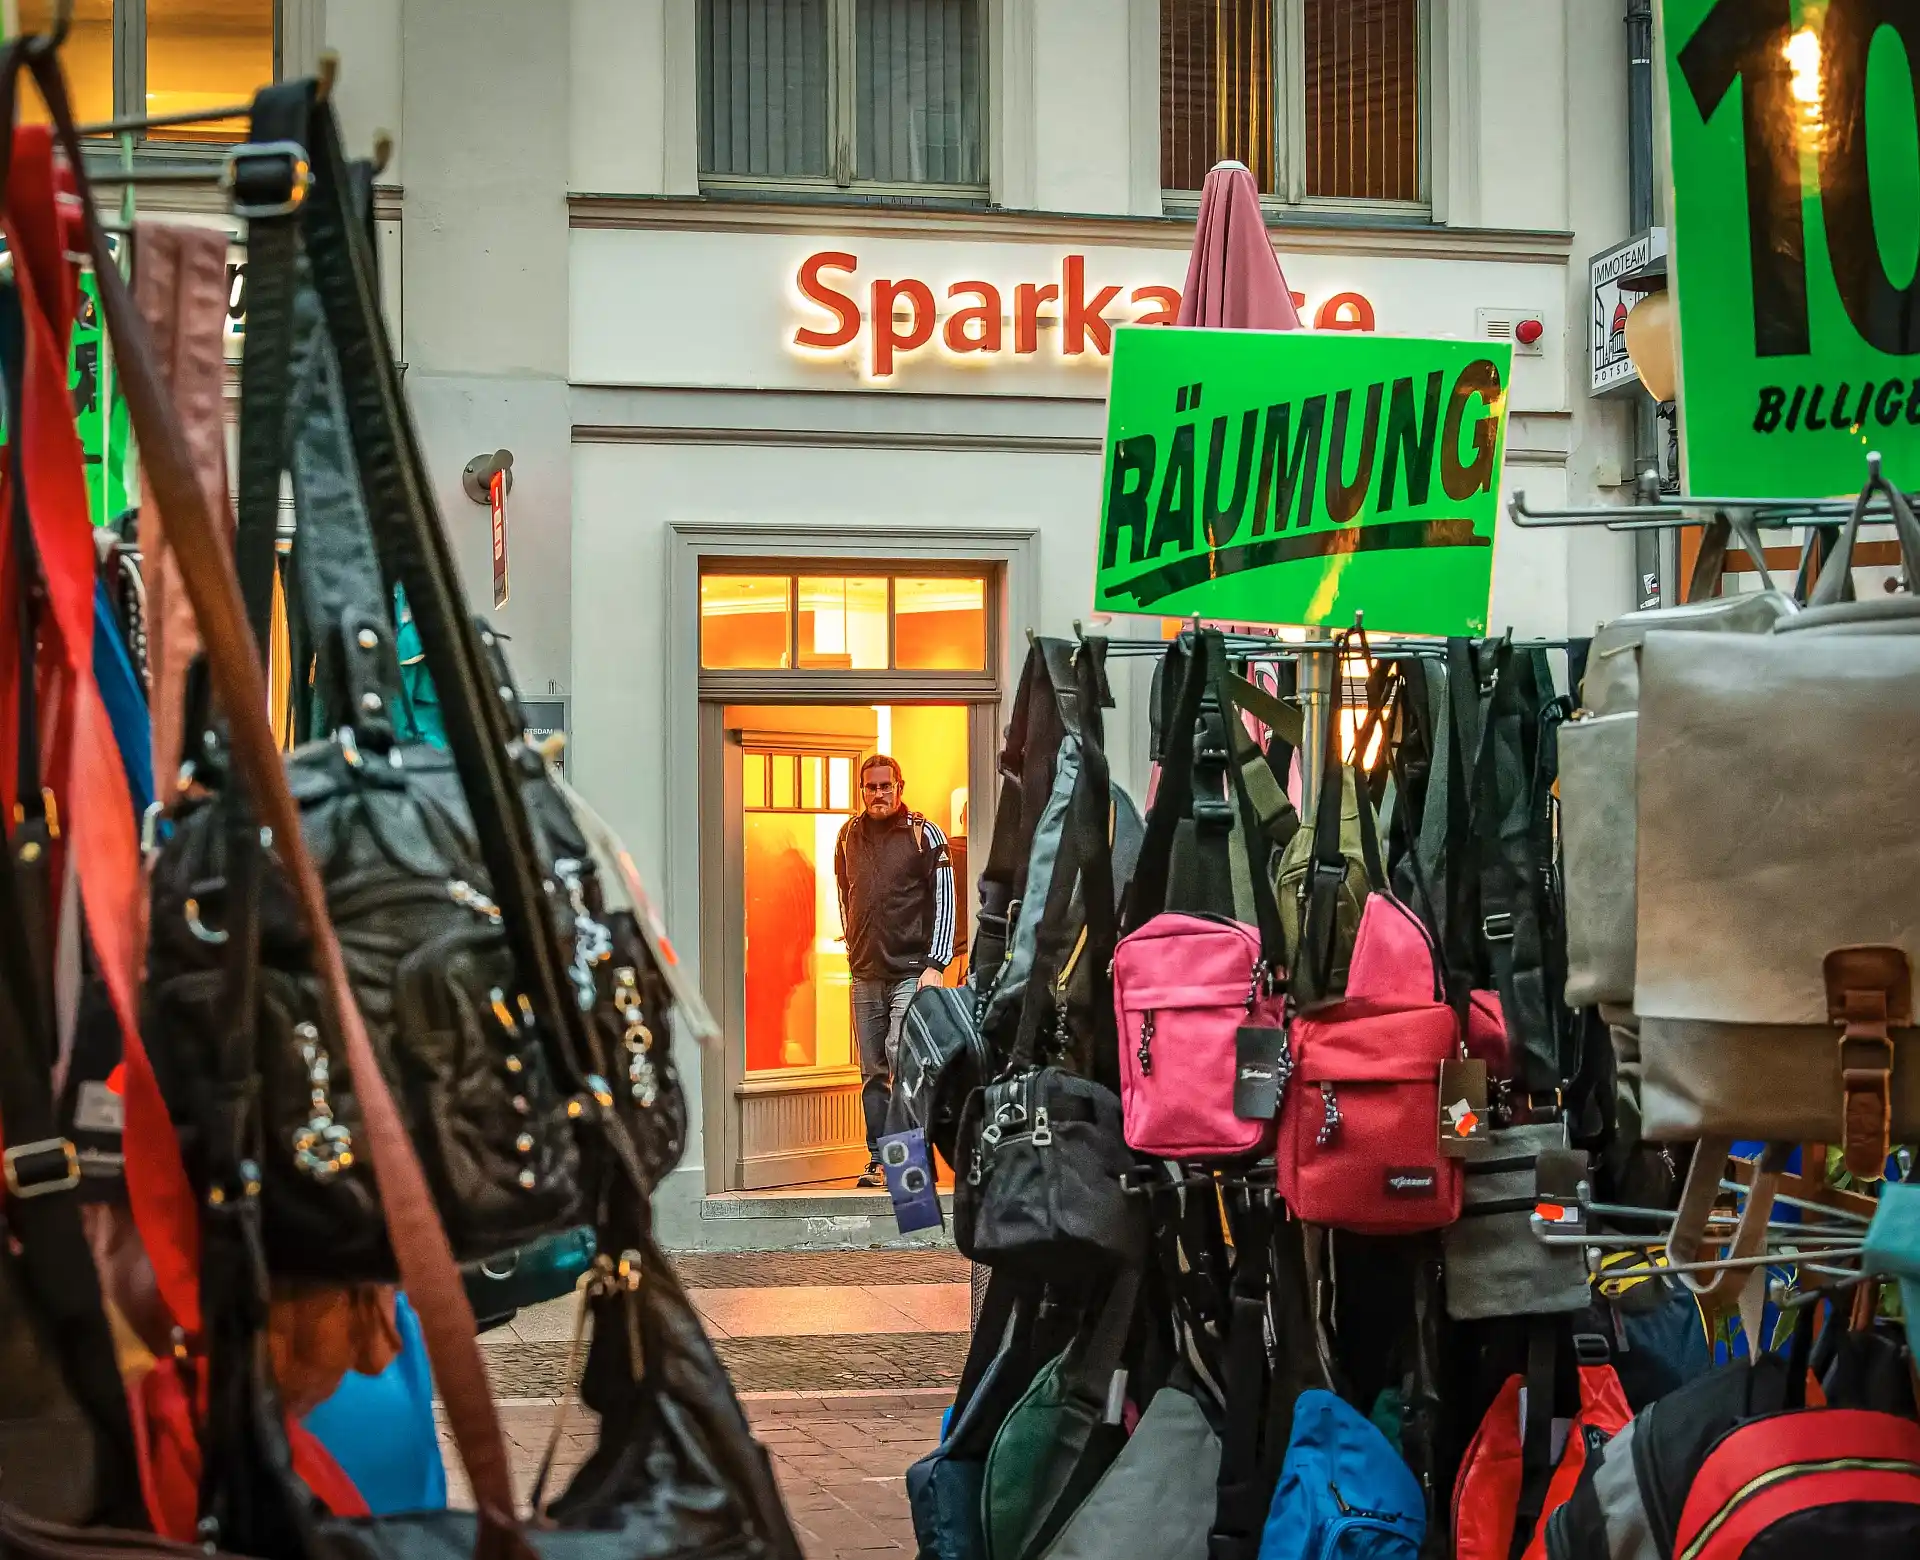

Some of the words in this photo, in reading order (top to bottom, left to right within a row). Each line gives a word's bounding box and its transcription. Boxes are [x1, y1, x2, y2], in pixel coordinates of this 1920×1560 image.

[1594, 243, 1647, 285] IMMOTEAM
[793, 251, 1375, 377] Sparkae
[1594, 361, 1634, 384] POTSD
[1102, 359, 1501, 570] RÄUMUNG
